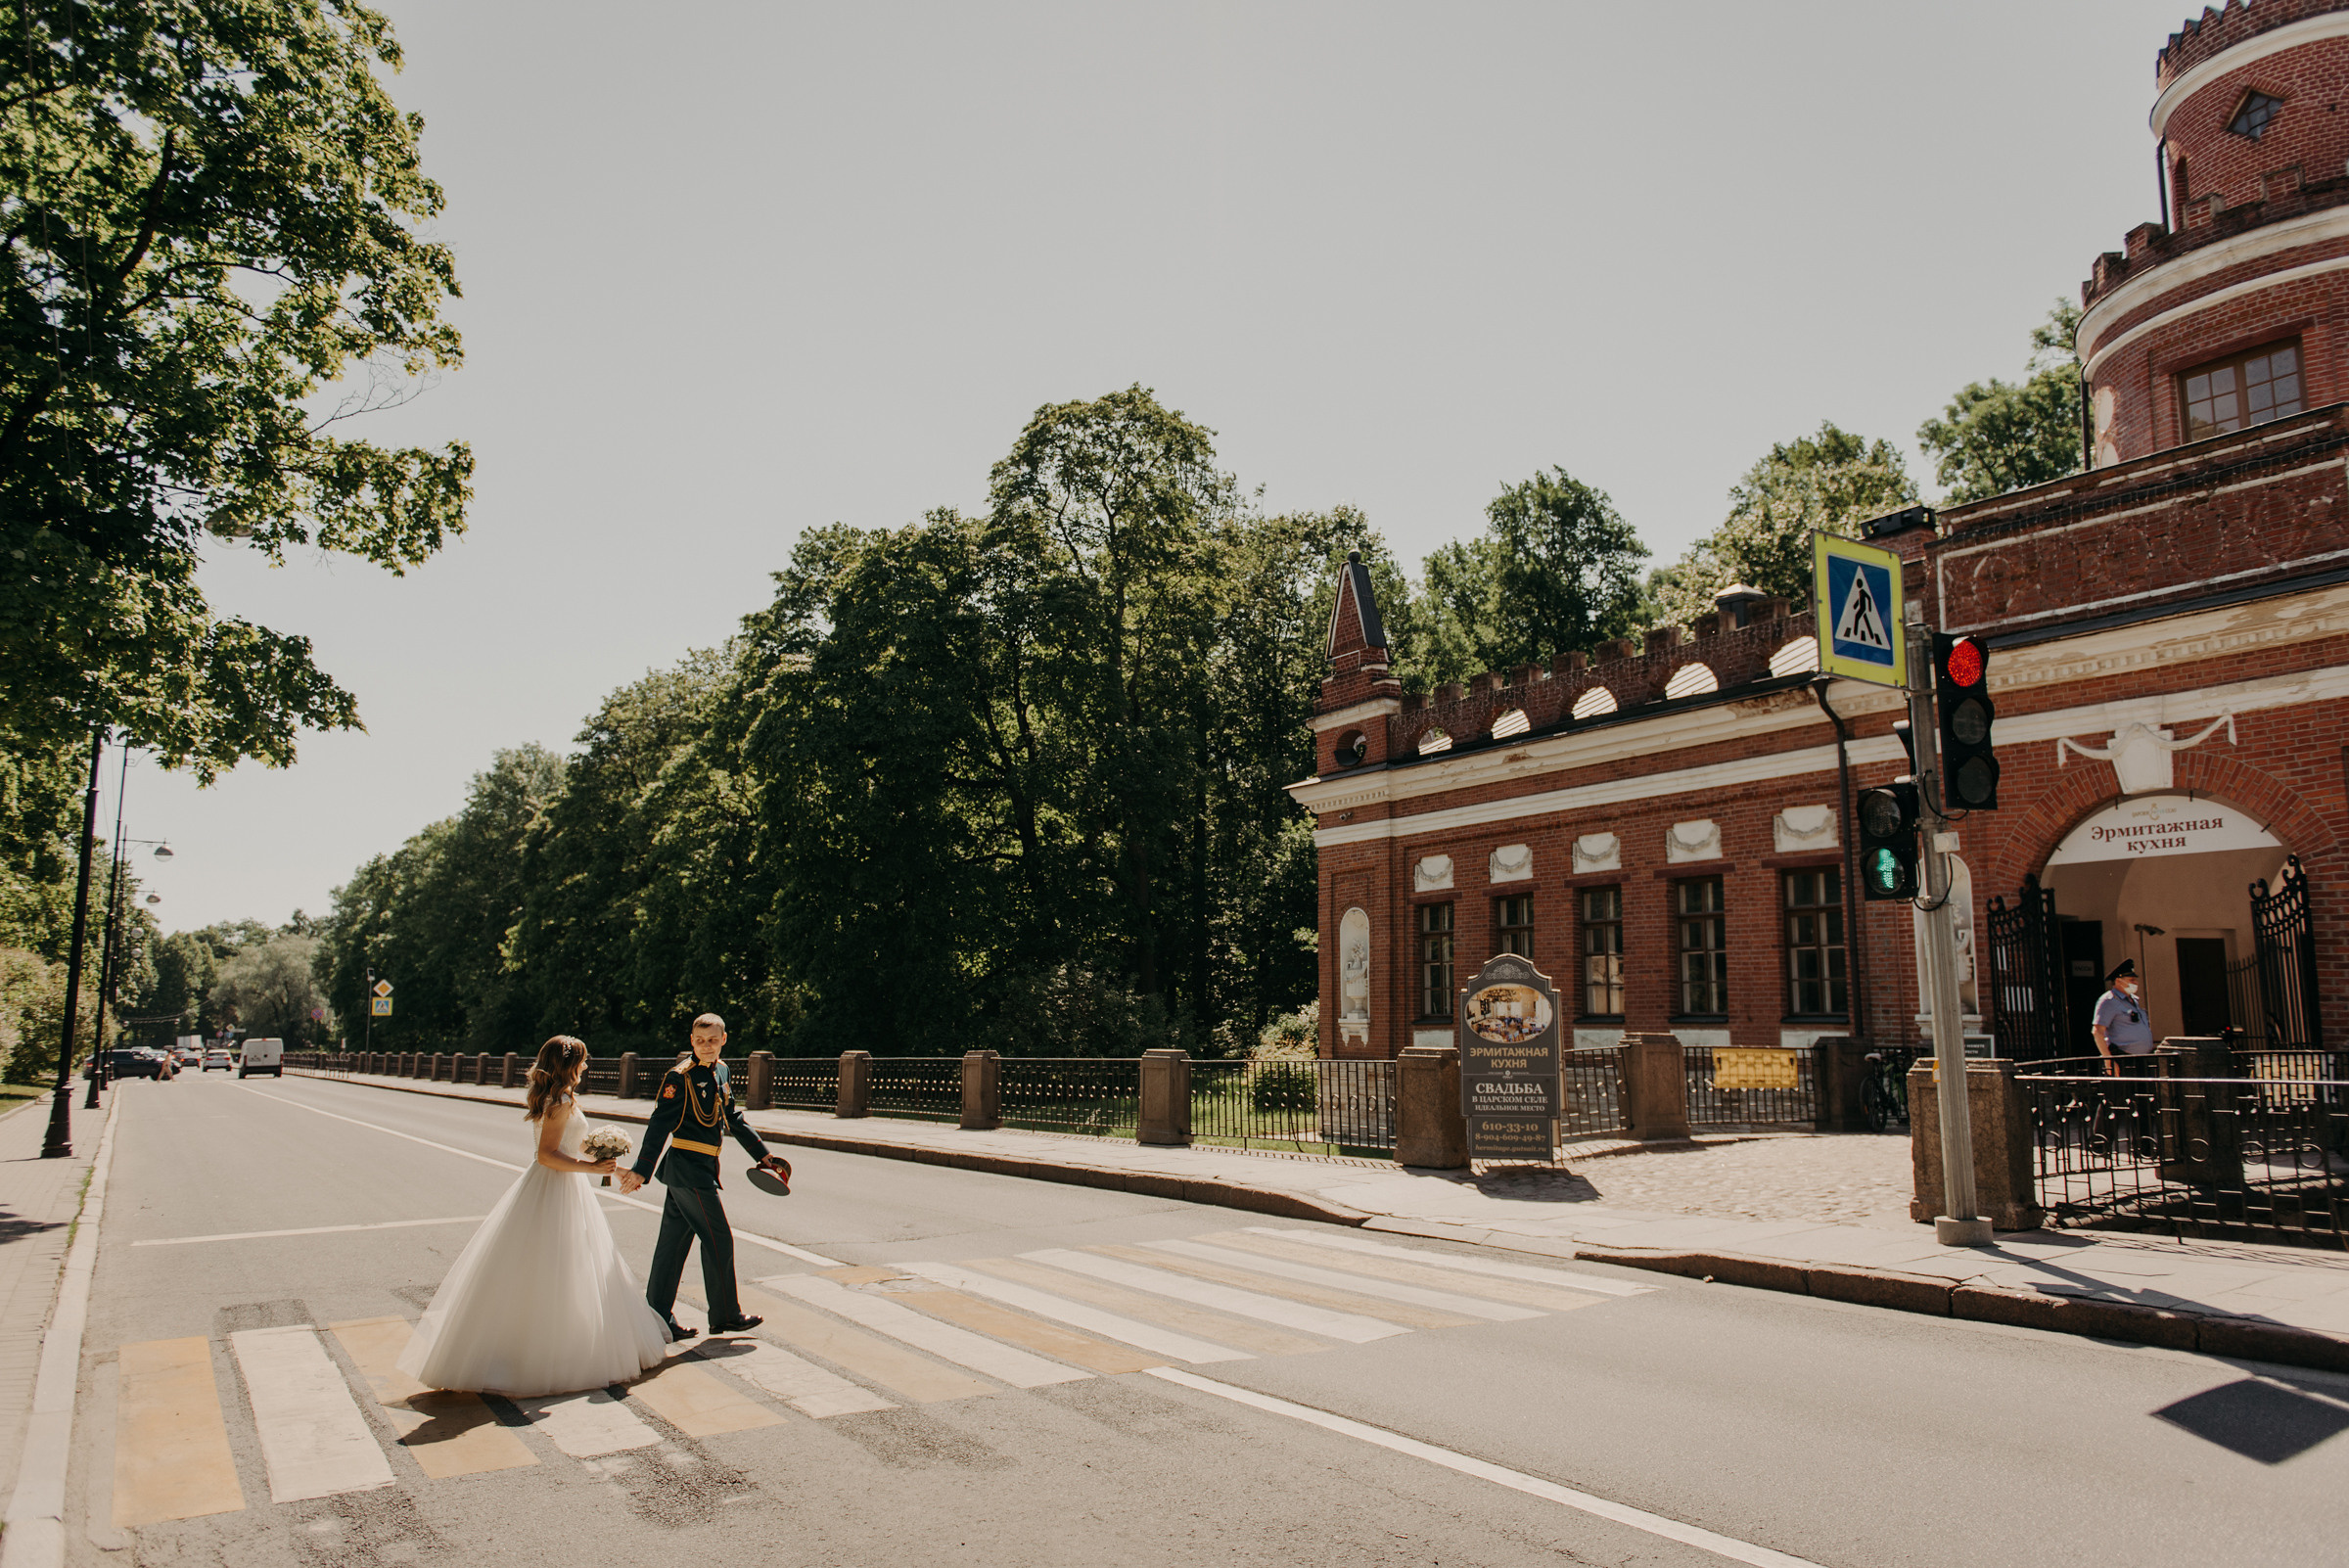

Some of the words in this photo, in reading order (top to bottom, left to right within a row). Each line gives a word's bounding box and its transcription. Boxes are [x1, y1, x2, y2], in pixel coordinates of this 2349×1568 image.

[2092, 817, 2224, 843] Эрмитажная
[2127, 837, 2187, 854] кухня
[1469, 1047, 1548, 1057] ЭРМИТАЖНАЯ
[1491, 1059, 1527, 1069] КУХНЯ
[1475, 1083, 1543, 1095] СВАДЬБА
[1482, 1121, 1539, 1133] 610-33-10
[1475, 1132, 1546, 1142] 8-904-609-49-87
